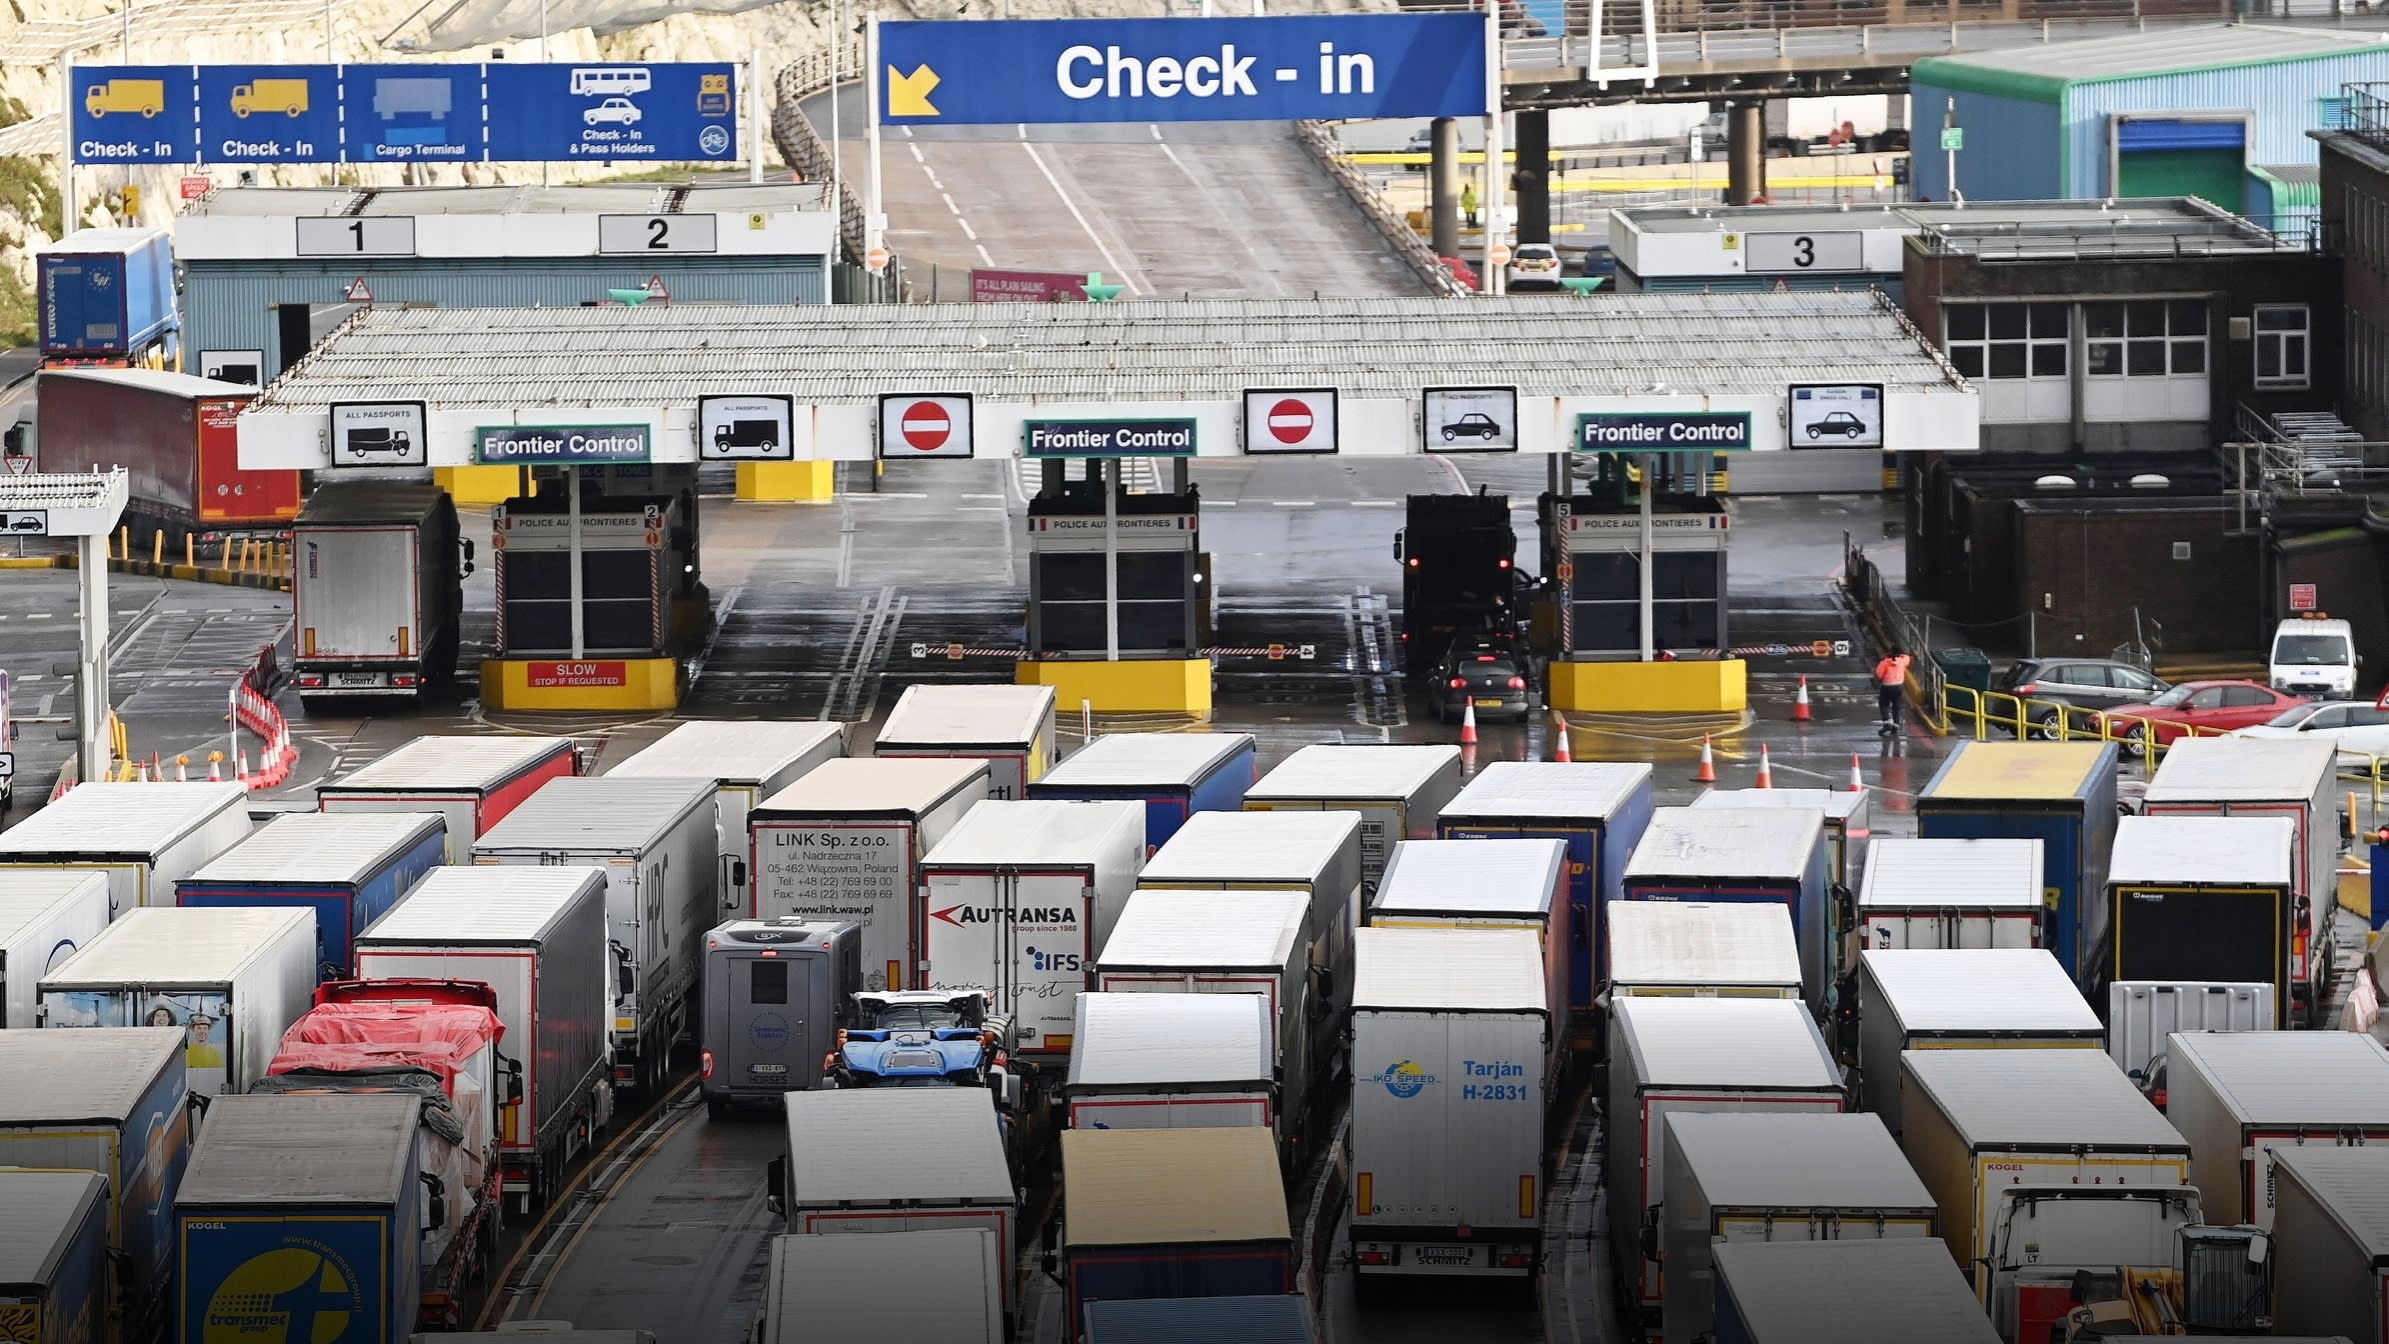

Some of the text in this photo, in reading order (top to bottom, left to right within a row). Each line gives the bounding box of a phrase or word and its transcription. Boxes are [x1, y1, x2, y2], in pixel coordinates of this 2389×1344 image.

[1056, 42, 1374, 99] Check - in
[583, 129, 618, 141] Check
[630, 130, 642, 140] In
[80, 141, 138, 157] Check
[155, 141, 172, 156] In
[222, 140, 282, 156] Check
[297, 140, 313, 156] In
[376, 143, 465, 157] Cargo Terminal
[570, 143, 655, 154] & Pass Holders
[348, 221, 363, 251] 1
[647, 219, 669, 249] 2
[1793, 236, 1815, 267] 3
[346, 410, 411, 419] ALL PASSPORTS
[1585, 421, 1744, 442] Frontier Control
[1032, 427, 1190, 449] Frontier Control
[484, 434, 645, 456] Frontier Control
[495, 507, 502, 518] 1
[647, 507, 656, 518] 2
[1560, 505, 1568, 515] 5
[519, 519, 553, 527] POLICE
[556, 519, 569, 527] AU
[1054, 520, 1088, 528] POLICE
[1117, 519, 1170, 528] RONTIERES
[1584, 520, 1618, 528] POLICE
[556, 664, 596, 676] SLOW
[535, 678, 556, 686] STOP
[568, 677, 619, 685] REQUESTED
[776, 833, 889, 849] LINK Sp. z o.o.
[788, 851, 877, 861] ul. Nadrzeczna 17
[767, 864, 899, 875] 05-462 Wiązowna, Poland
[777, 876, 893, 887] Tel: +48 (22) 769 69 00
[773, 889, 893, 900] Fax: +48 (22) 769 69 69
[792, 904, 874, 915] www.link.waw.pl
[1011, 925, 1035, 933] group
[1045, 954, 1080, 971] IFS
[1463, 1060, 1523, 1079] Tarján
[749, 1075, 787, 1085] HORSES
[1373, 1075, 1391, 1083] IKO
[1397, 1075, 1435, 1083] SPEED
[1463, 1085, 1526, 1100] H-2831
[1417, 1256, 1471, 1265] SCHMITZ
[2027, 1255, 2038, 1263] LT
[282, 1236, 363, 1313] www.transmecgroup.it
[209, 1313, 288, 1326] transmec
[240, 1325, 268, 1333] group
